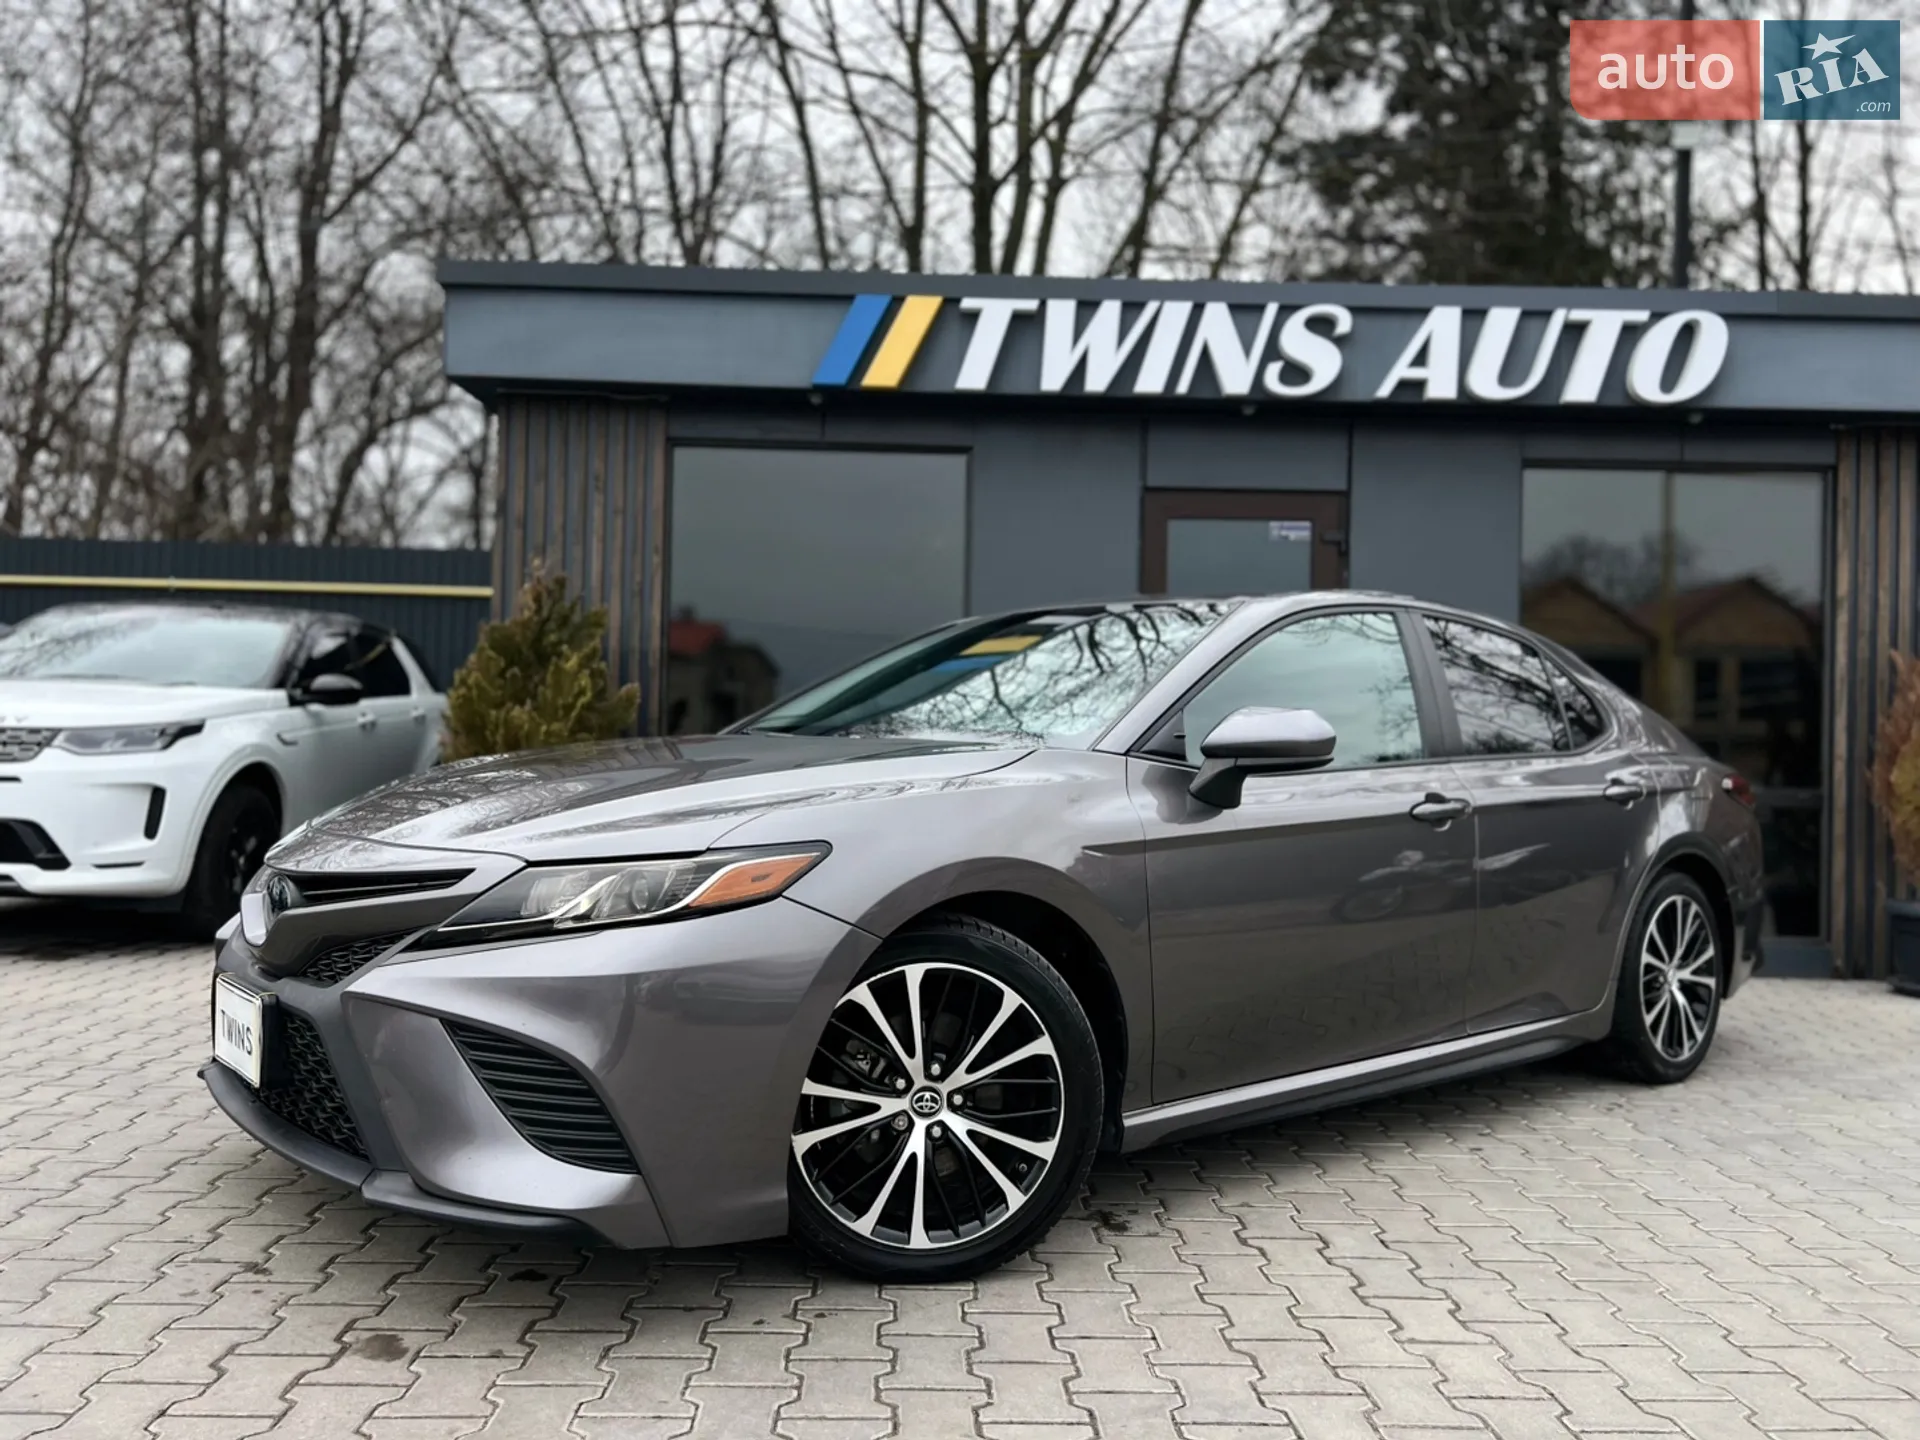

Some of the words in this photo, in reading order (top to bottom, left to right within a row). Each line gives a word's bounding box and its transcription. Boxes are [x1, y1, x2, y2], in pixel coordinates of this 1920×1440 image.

[954, 296, 1354, 398] TWINS
[1375, 305, 1730, 404] AUTO
[220, 1009, 253, 1055] TWINS
